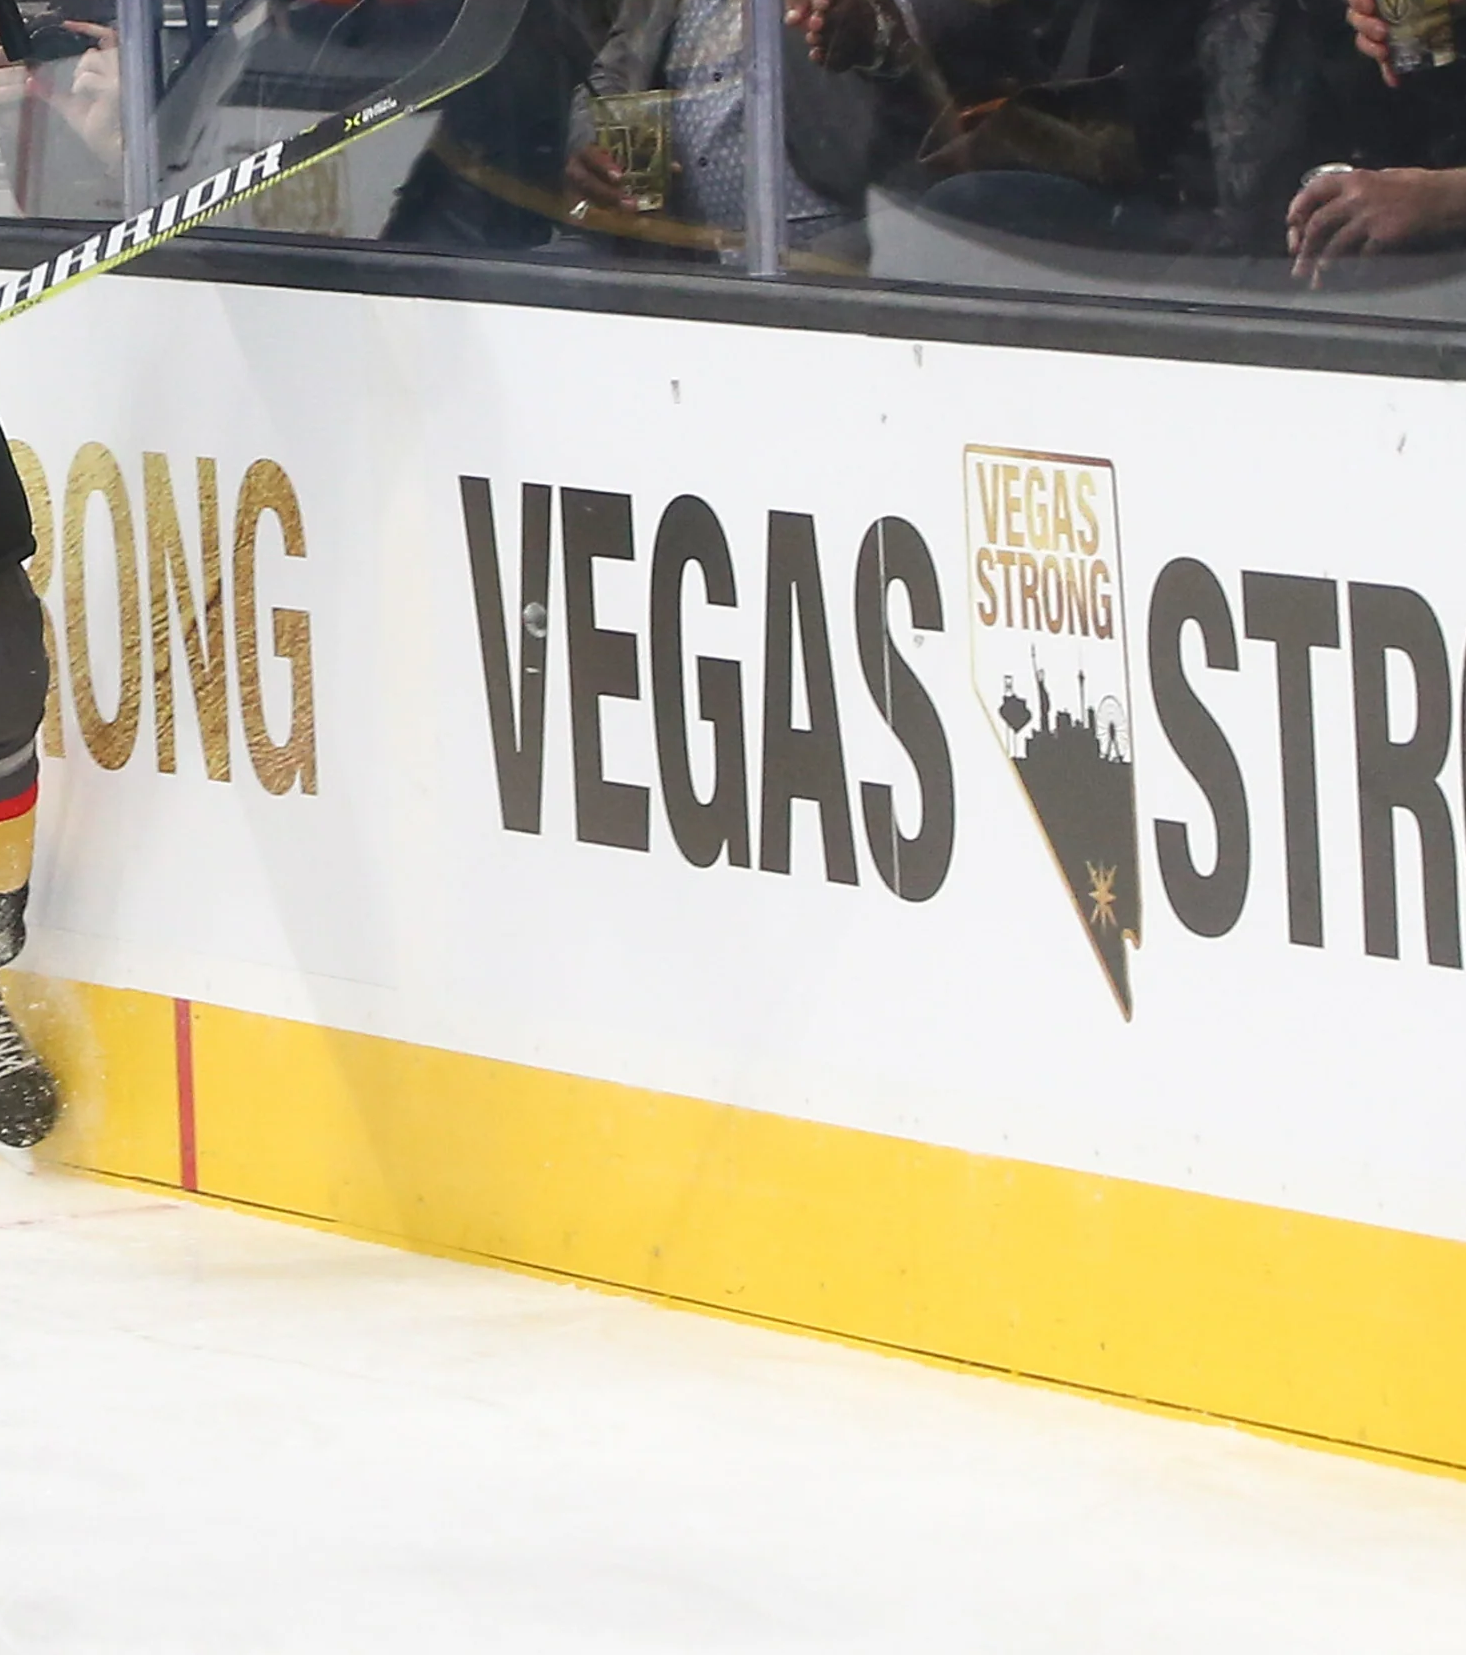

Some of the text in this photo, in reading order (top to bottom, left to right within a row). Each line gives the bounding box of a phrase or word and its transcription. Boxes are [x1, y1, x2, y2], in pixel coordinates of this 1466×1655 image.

[976, 462, 1100, 556] VEGAS
[976, 547, 1114, 640] STRONG
[459, 475, 957, 903] VEGAS
